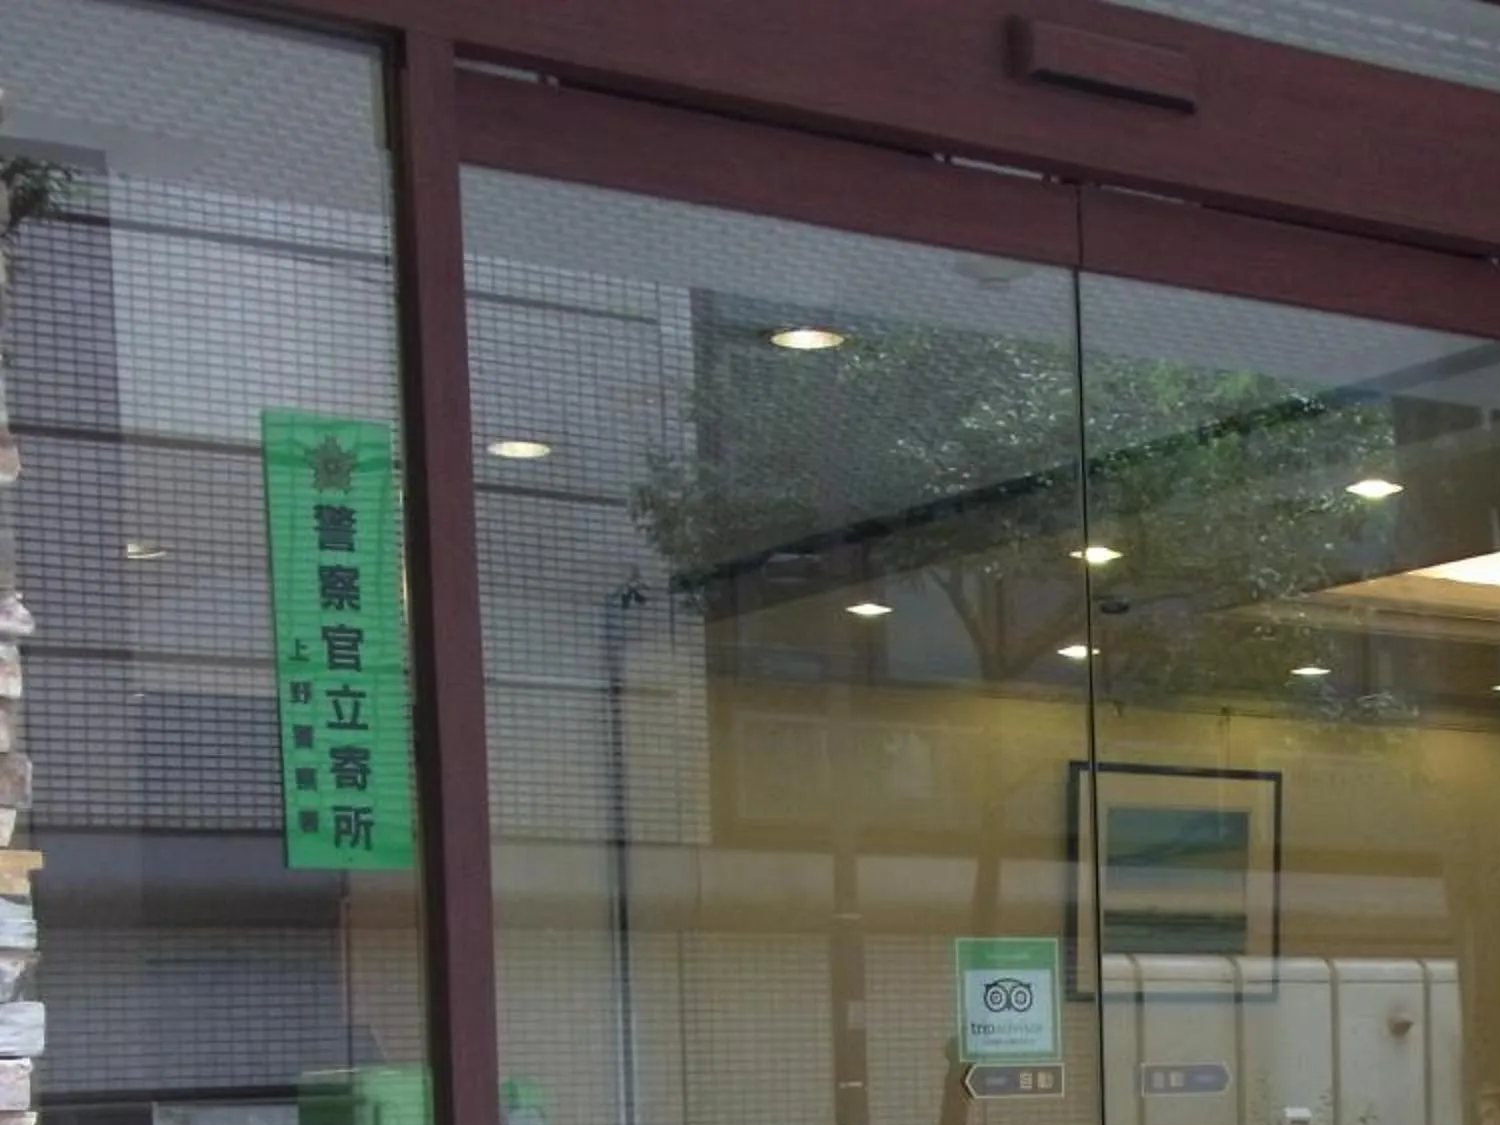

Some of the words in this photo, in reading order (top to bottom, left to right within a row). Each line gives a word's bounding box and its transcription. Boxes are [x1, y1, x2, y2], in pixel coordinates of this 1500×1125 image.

[313, 504, 375, 852] 警察官立寄所
